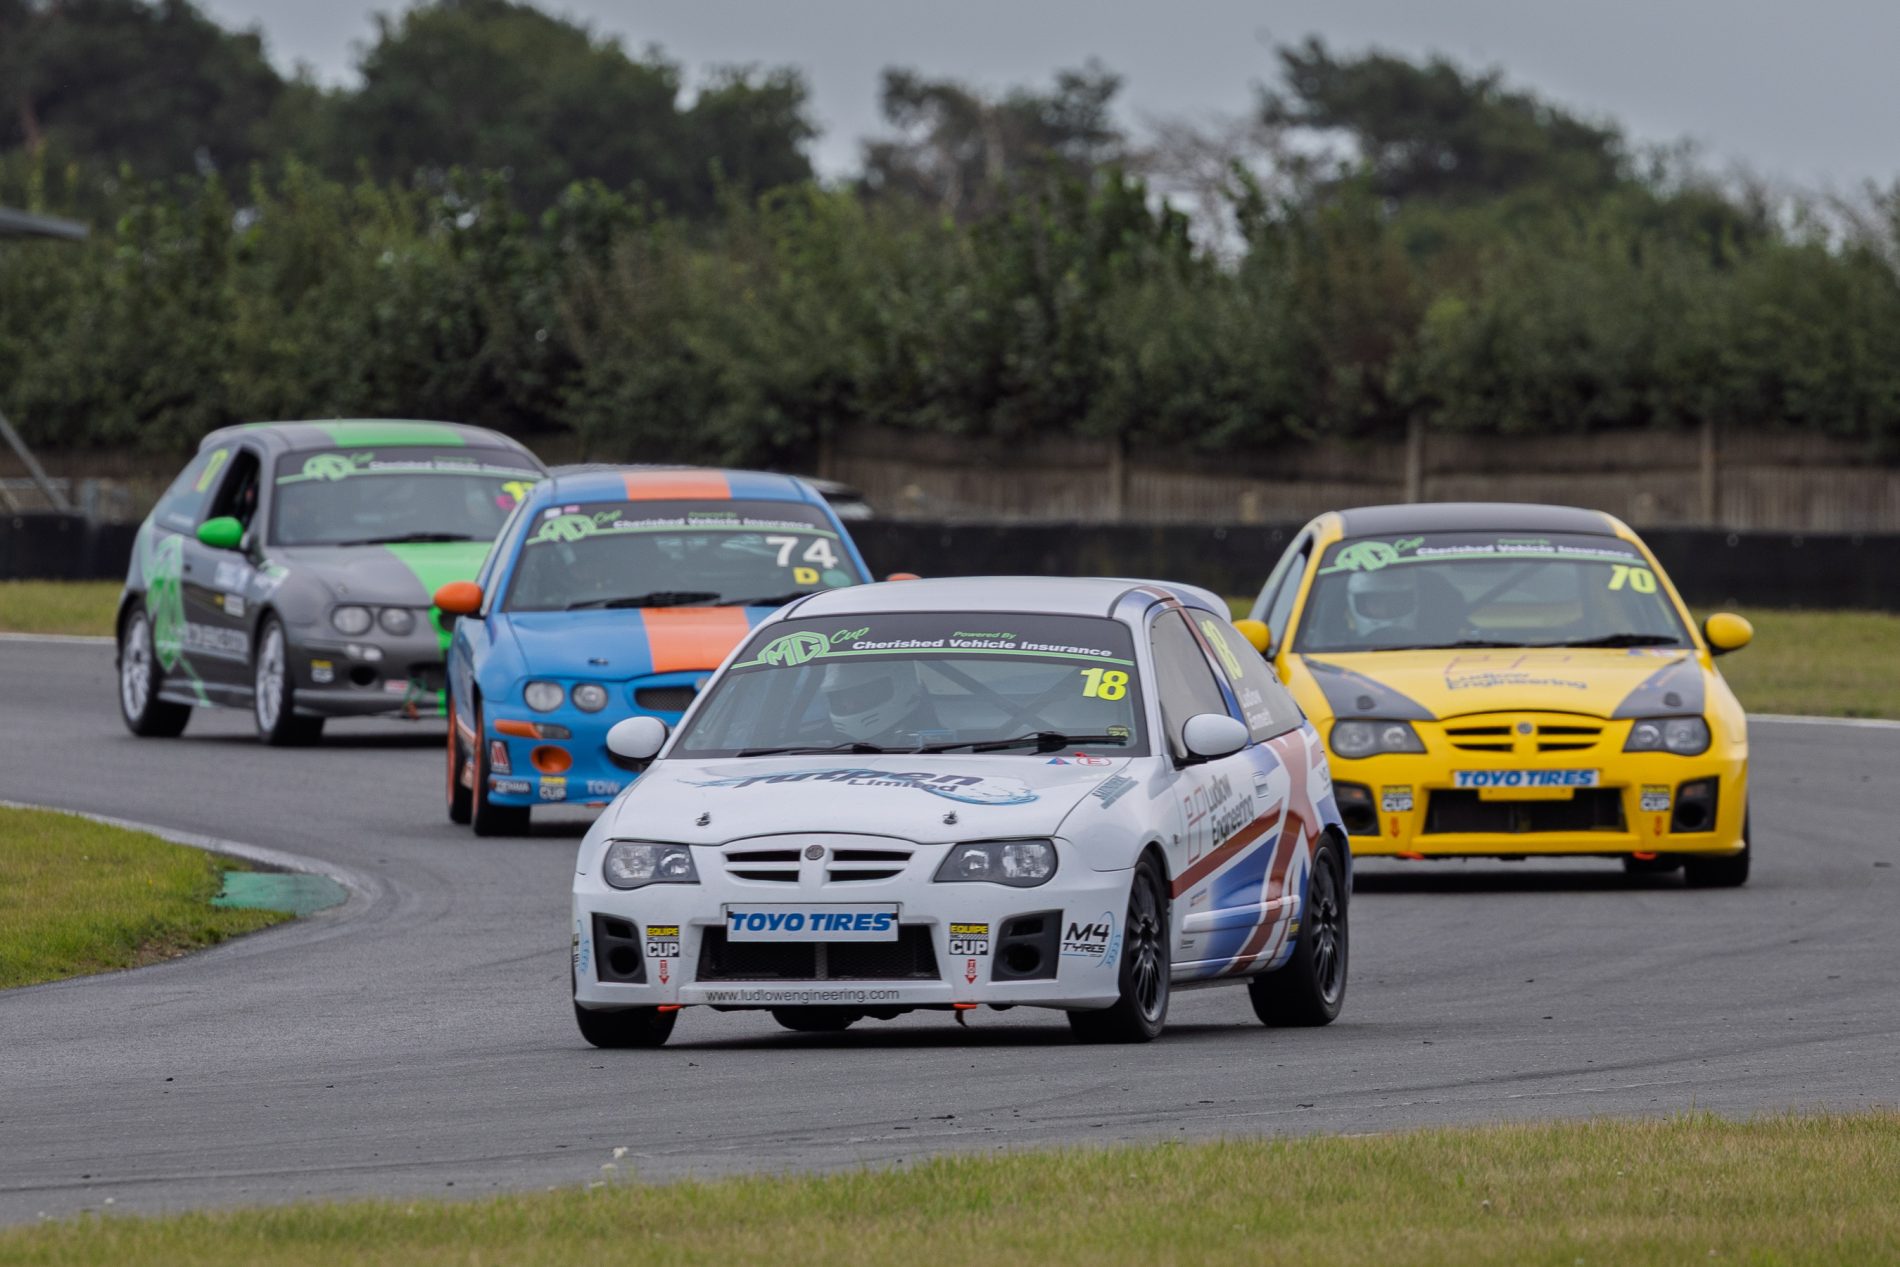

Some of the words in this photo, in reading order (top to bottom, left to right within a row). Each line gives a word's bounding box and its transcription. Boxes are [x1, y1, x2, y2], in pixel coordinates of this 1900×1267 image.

[613, 518, 685, 529] Cherished
[688, 517, 741, 528] Vehicle
[766, 536, 839, 569] 74
[1416, 545, 1495, 556] Cherished
[792, 566, 820, 585] D
[1608, 564, 1657, 593] 70
[953, 631, 1000, 639] Powered
[1000, 632, 1016, 640] By
[757, 631, 830, 667] MG
[830, 627, 870, 645] Cup
[852, 639, 945, 650] Cherished
[949, 638, 1016, 649] Vehicle
[1021, 641, 1113, 657] Insurance
[1080, 667, 1129, 701] 18
[848, 779, 960, 793] Limited
[1459, 770, 1521, 786] TOYO
[1526, 770, 1595, 786] TIRES
[1211, 792, 1255, 847] Engineering
[731, 912, 805, 932] TOYO
[809, 912, 893, 932] TIRES
[950, 924, 988, 934] EQUIPE
[1064, 922, 1110, 943] M4
[647, 942, 679, 957] CUP
[950, 939, 988, 955] CUP
[1062, 942, 1107, 953] TYRES
[705, 988, 900, 1003] www.ludlowengineering.com
